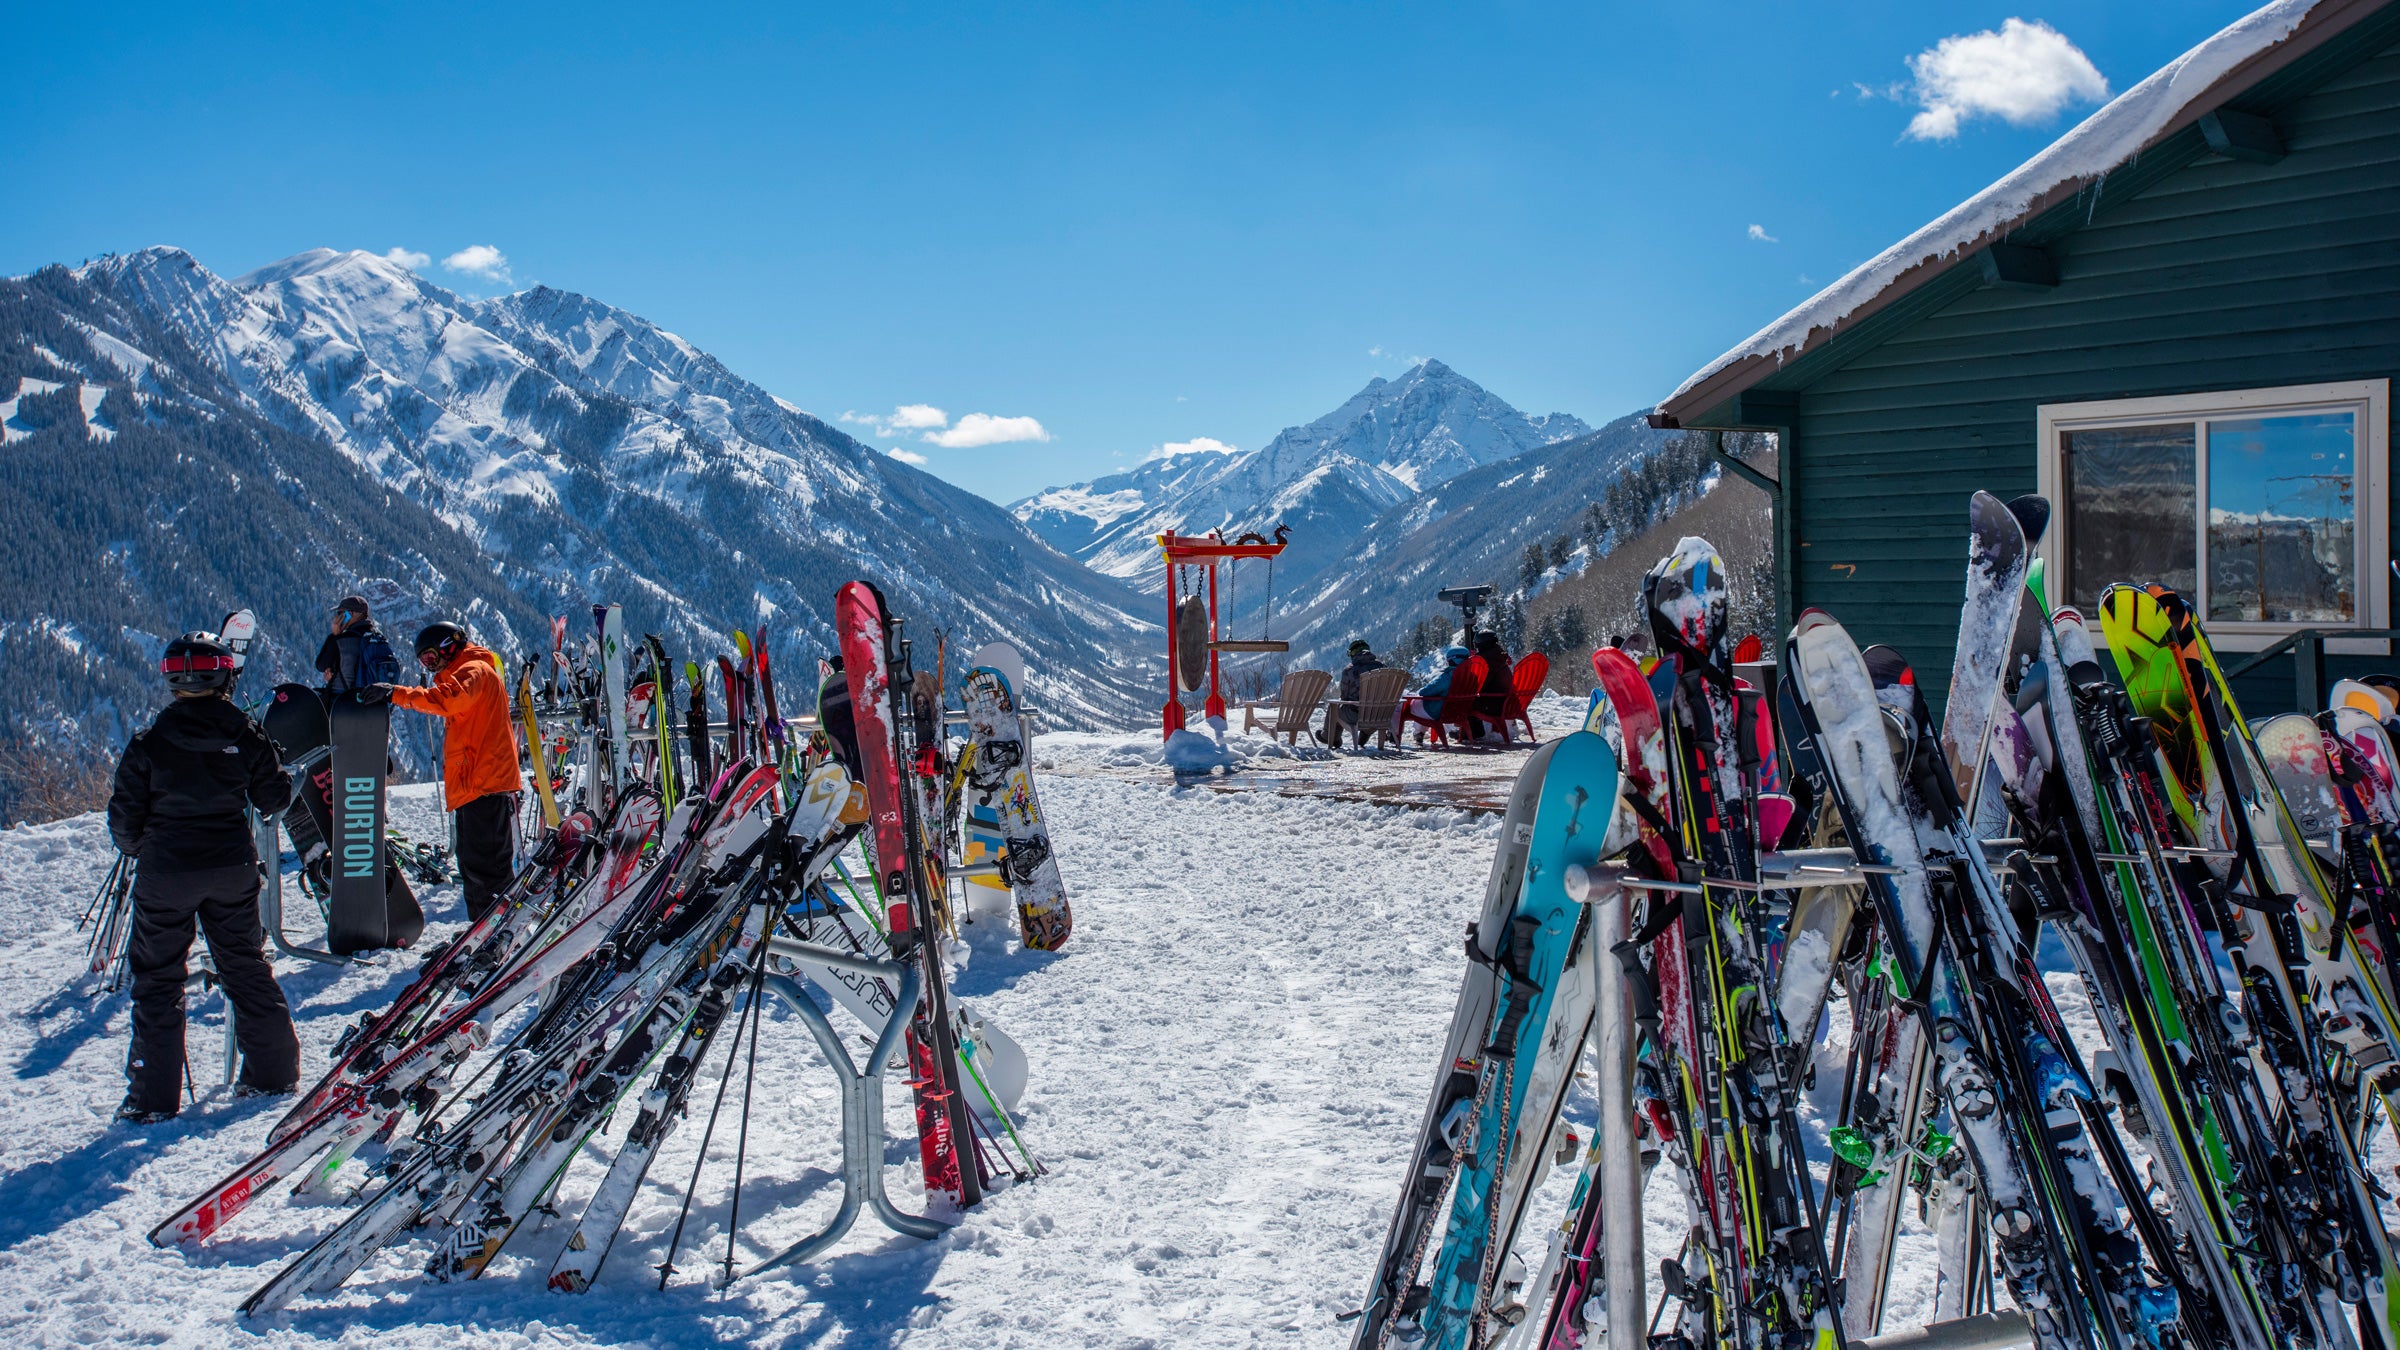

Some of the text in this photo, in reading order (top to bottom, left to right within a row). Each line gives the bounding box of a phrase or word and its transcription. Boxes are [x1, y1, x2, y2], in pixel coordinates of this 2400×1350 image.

[343, 777, 375, 877] BURTON
[1753, 848, 1767, 933] SCOTT
[2029, 884, 2049, 907] LEKI
[827, 965, 893, 1018] BURT
[1701, 1001, 1709, 1025] SPORTS
[2022, 958, 2064, 1028] FORCE
[2080, 970, 2104, 1009] LEKI
[1702, 1031, 1720, 1124] SCOTT
[1766, 1024, 1795, 1114] SCOTT
[252, 1171, 269, 1187] 176
[1669, 1110, 1704, 1207] SCOTT
